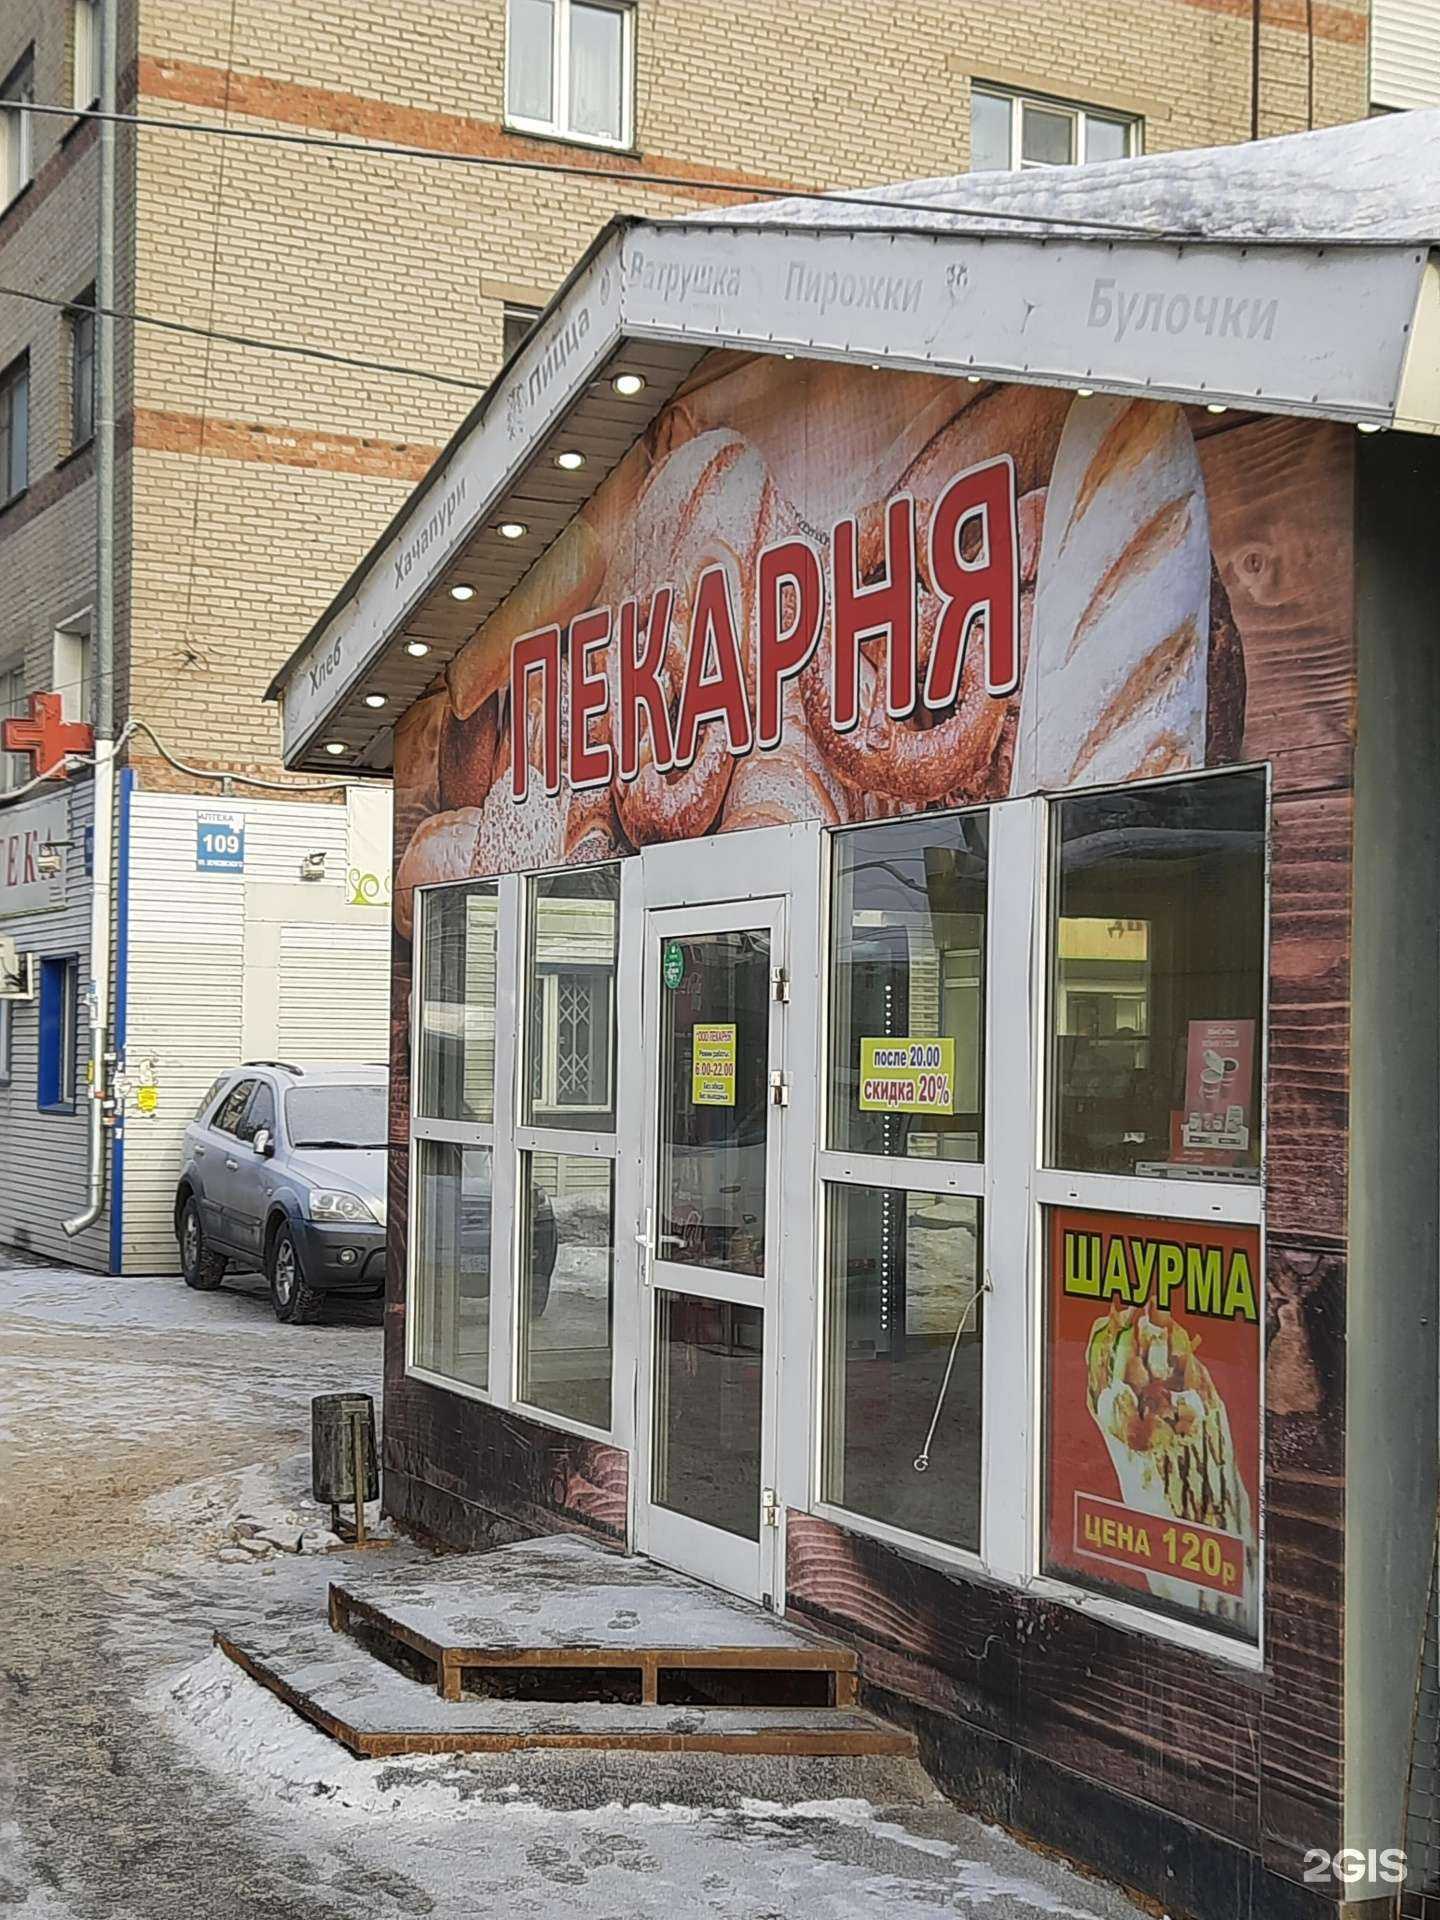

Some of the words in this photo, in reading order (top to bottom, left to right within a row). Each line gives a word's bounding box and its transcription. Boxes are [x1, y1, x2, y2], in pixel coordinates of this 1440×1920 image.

[628, 250, 742, 302] Ватрушка
[784, 260, 924, 316] Пирожки
[1086, 277, 1279, 343] Булочки
[309, 635, 342, 697] Хлеб
[394, 478, 467, 590] Хачапури
[528, 307, 590, 406] Пицца
[511, 453, 1019, 803] ПЕКАРНЯ
[203, 834, 239, 854] 109
[864, 1081, 914, 1106] скидка
[919, 1075, 949, 1104] 20%
[874, 1050, 907, 1066] после
[910, 1046, 940, 1067] 20.00
[1064, 1230, 1258, 1322] ШАУРМА
[1084, 1512, 1151, 1557] ЦЕНА
[1162, 1527, 1236, 1584] 120р
